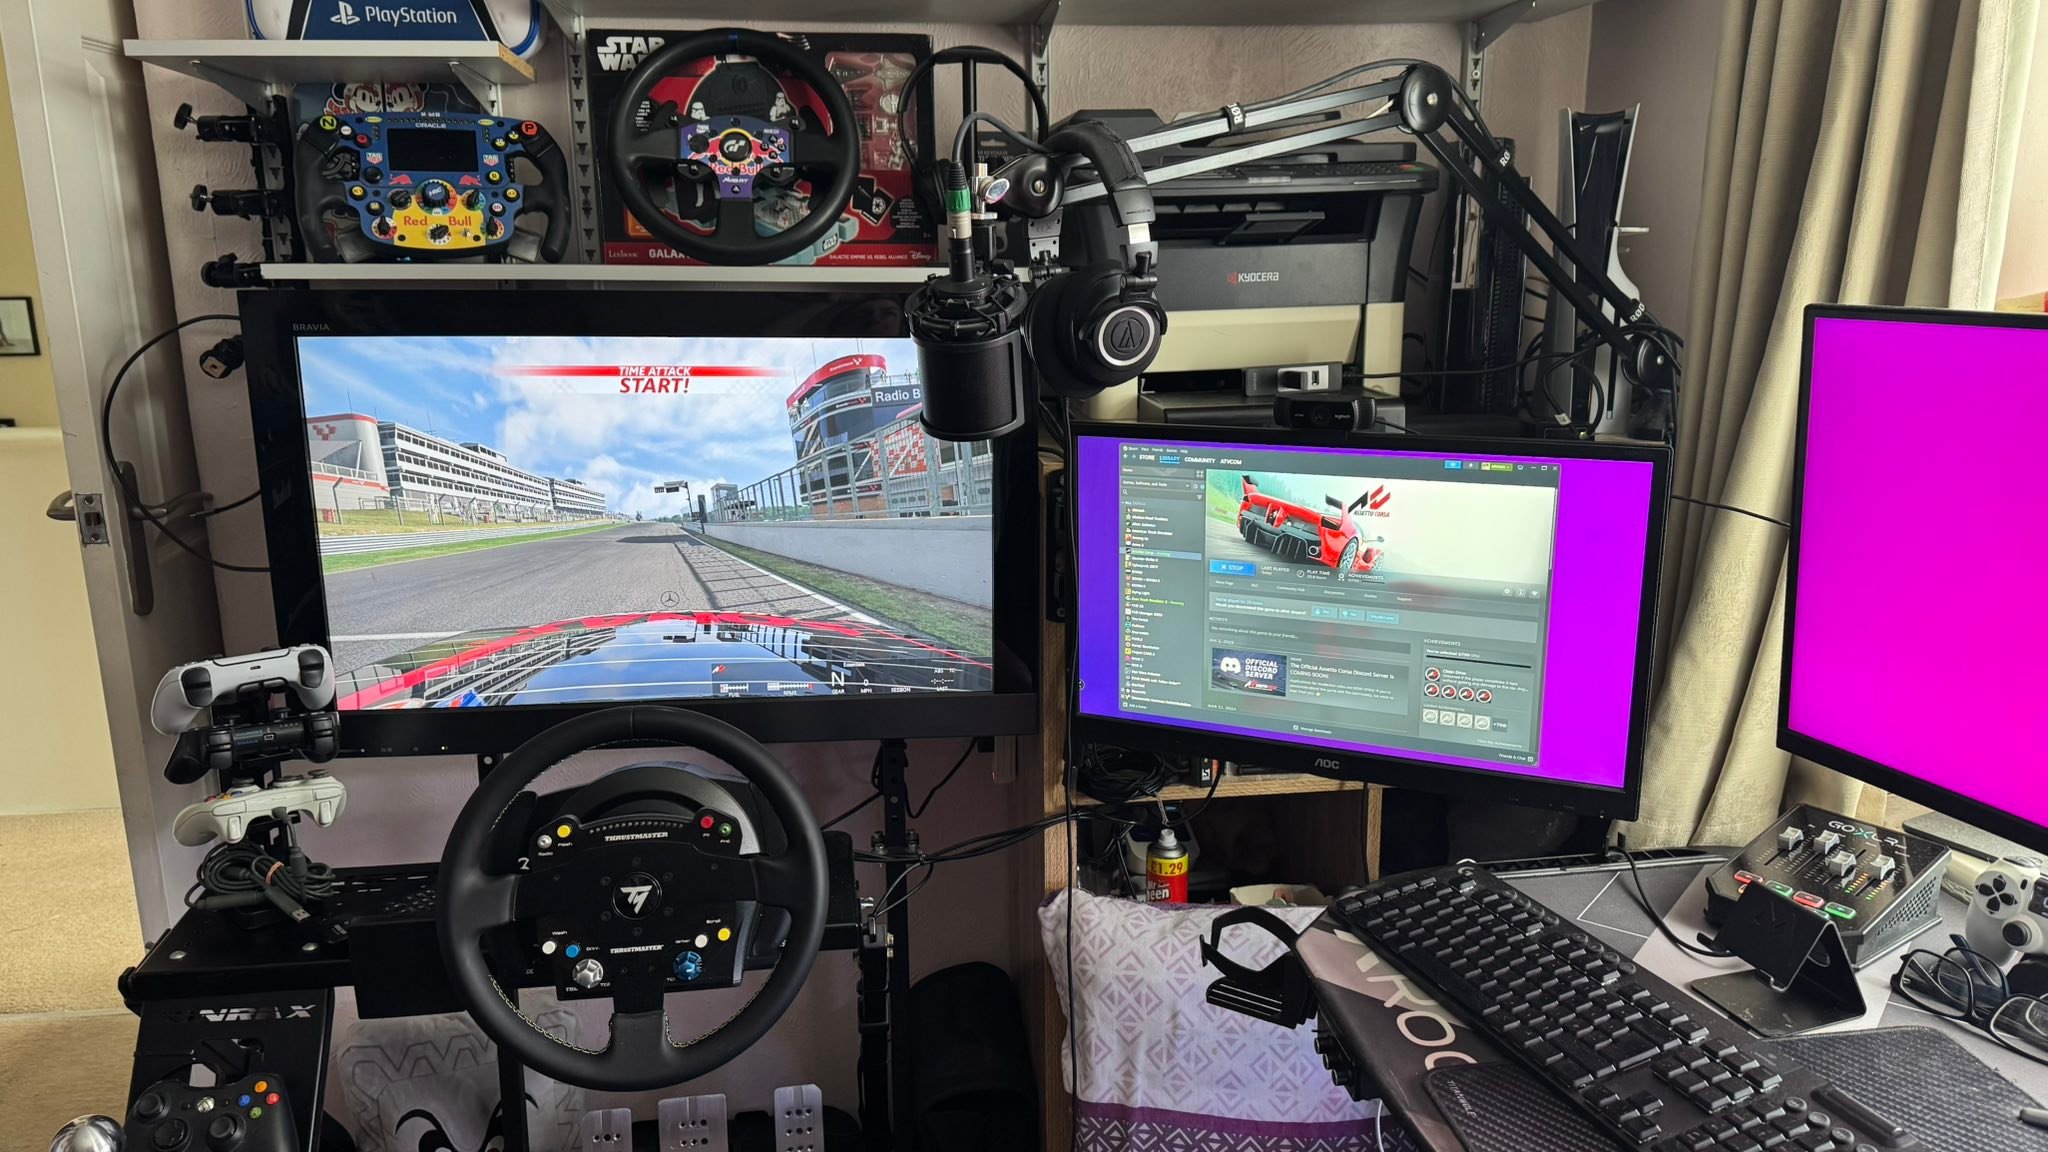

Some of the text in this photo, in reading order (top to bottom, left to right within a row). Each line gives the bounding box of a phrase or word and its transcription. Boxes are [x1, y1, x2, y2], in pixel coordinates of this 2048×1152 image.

[365, 6, 457, 27] PlayStation
[322, 118, 335, 128] N
[415, 122, 447, 130] ORACLE
[524, 123, 535, 133] P
[403, 215, 472, 226] Red Bull
[909, 250, 931, 262] Disney
[1238, 271, 1280, 282] KYOCERA
[292, 323, 330, 331] BRAVIA
[618, 366, 691, 377] TIME ATTACK
[619, 377, 690, 394] START!
[874, 389, 910, 403] Radio
[1184, 456, 1216, 464] COMMUNITY
[1353, 509, 1374, 517] ASSETTO
[1244, 658, 1279, 668] OFFICIAL
[1244, 665, 1278, 674] DISCORD
[1299, 663, 1318, 671] Official
[1337, 667, 1352, 675] Corsa
[1353, 669, 1372, 678] Discord
[1372, 671, 1389, 679] Server
[831, 672, 845, 687] N
[1244, 671, 1274, 680] SERVER
[1314, 758, 1340, 770] AOC
[604, 831, 668, 842] THRUSTMASTER
[1151, 860, 1183, 875] £1.29
[609, 944, 662, 954] THRUSTMASTER
